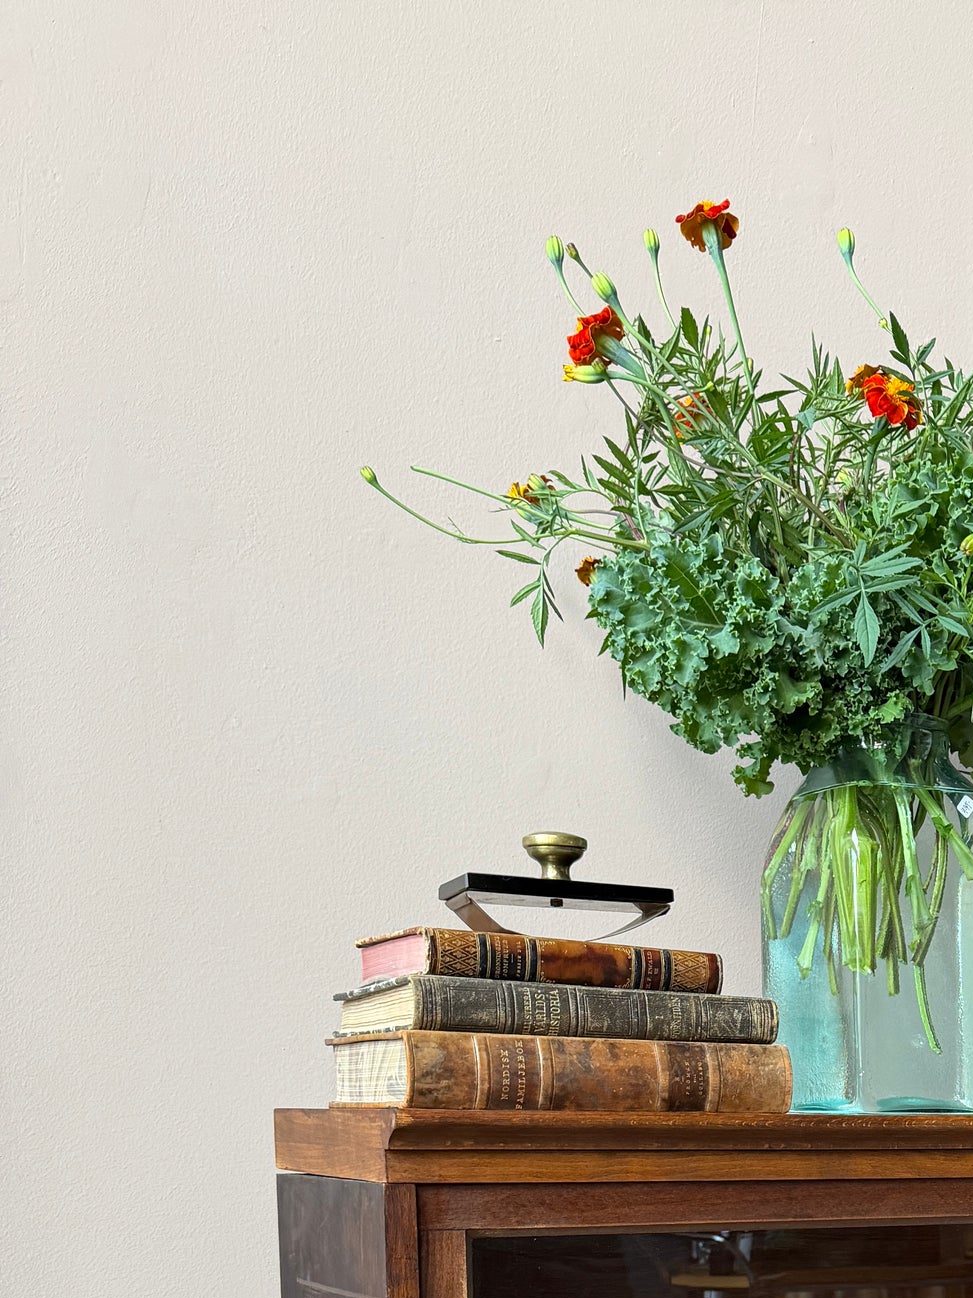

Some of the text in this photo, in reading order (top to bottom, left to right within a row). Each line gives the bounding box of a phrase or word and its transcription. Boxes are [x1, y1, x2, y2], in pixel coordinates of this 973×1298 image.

[548, 989, 561, 1037] HISTORIA
[500, 1049, 510, 1100] NORDISK
[514, 1040, 526, 1110] FAMILJEBOK
